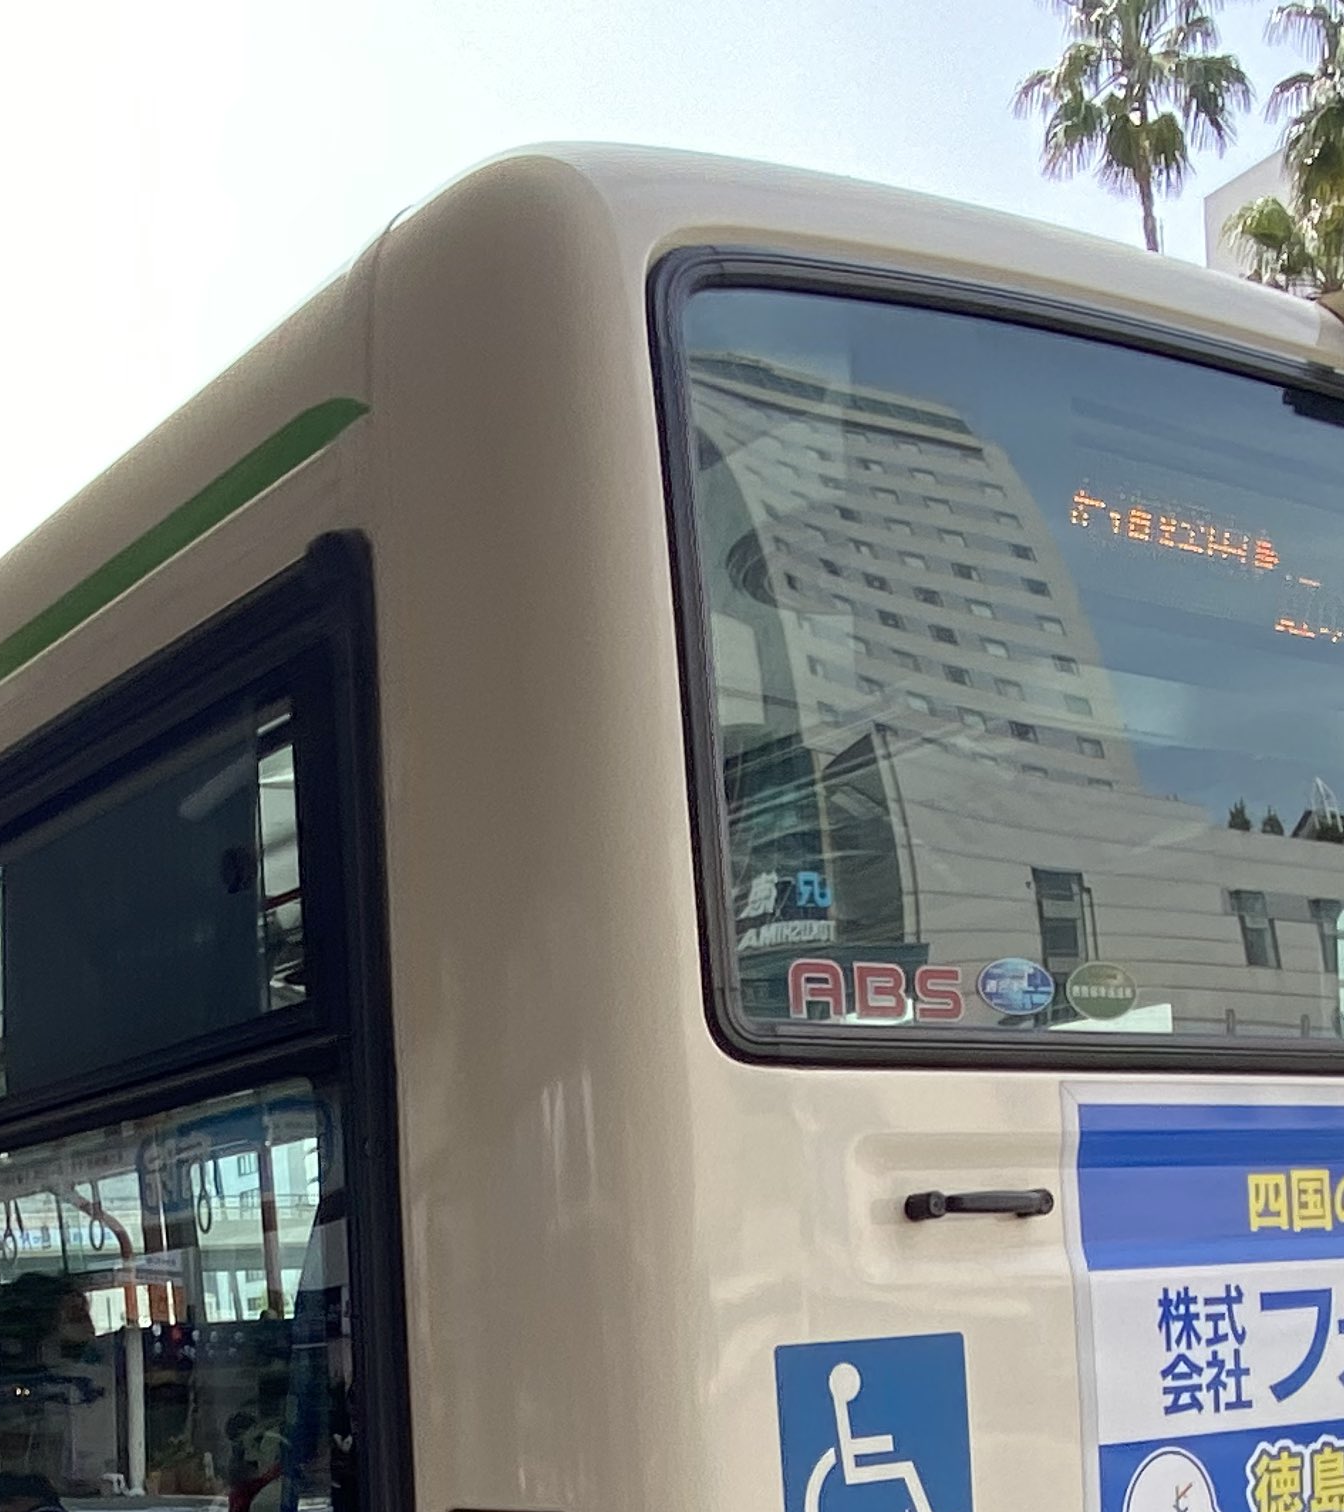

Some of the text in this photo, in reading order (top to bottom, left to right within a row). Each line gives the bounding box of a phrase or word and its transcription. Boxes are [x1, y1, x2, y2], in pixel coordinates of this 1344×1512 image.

[787, 958, 965, 1022] ABS
[1157, 1282, 1246, 1354] 株式
[1159, 1348, 1254, 1415] 会社
